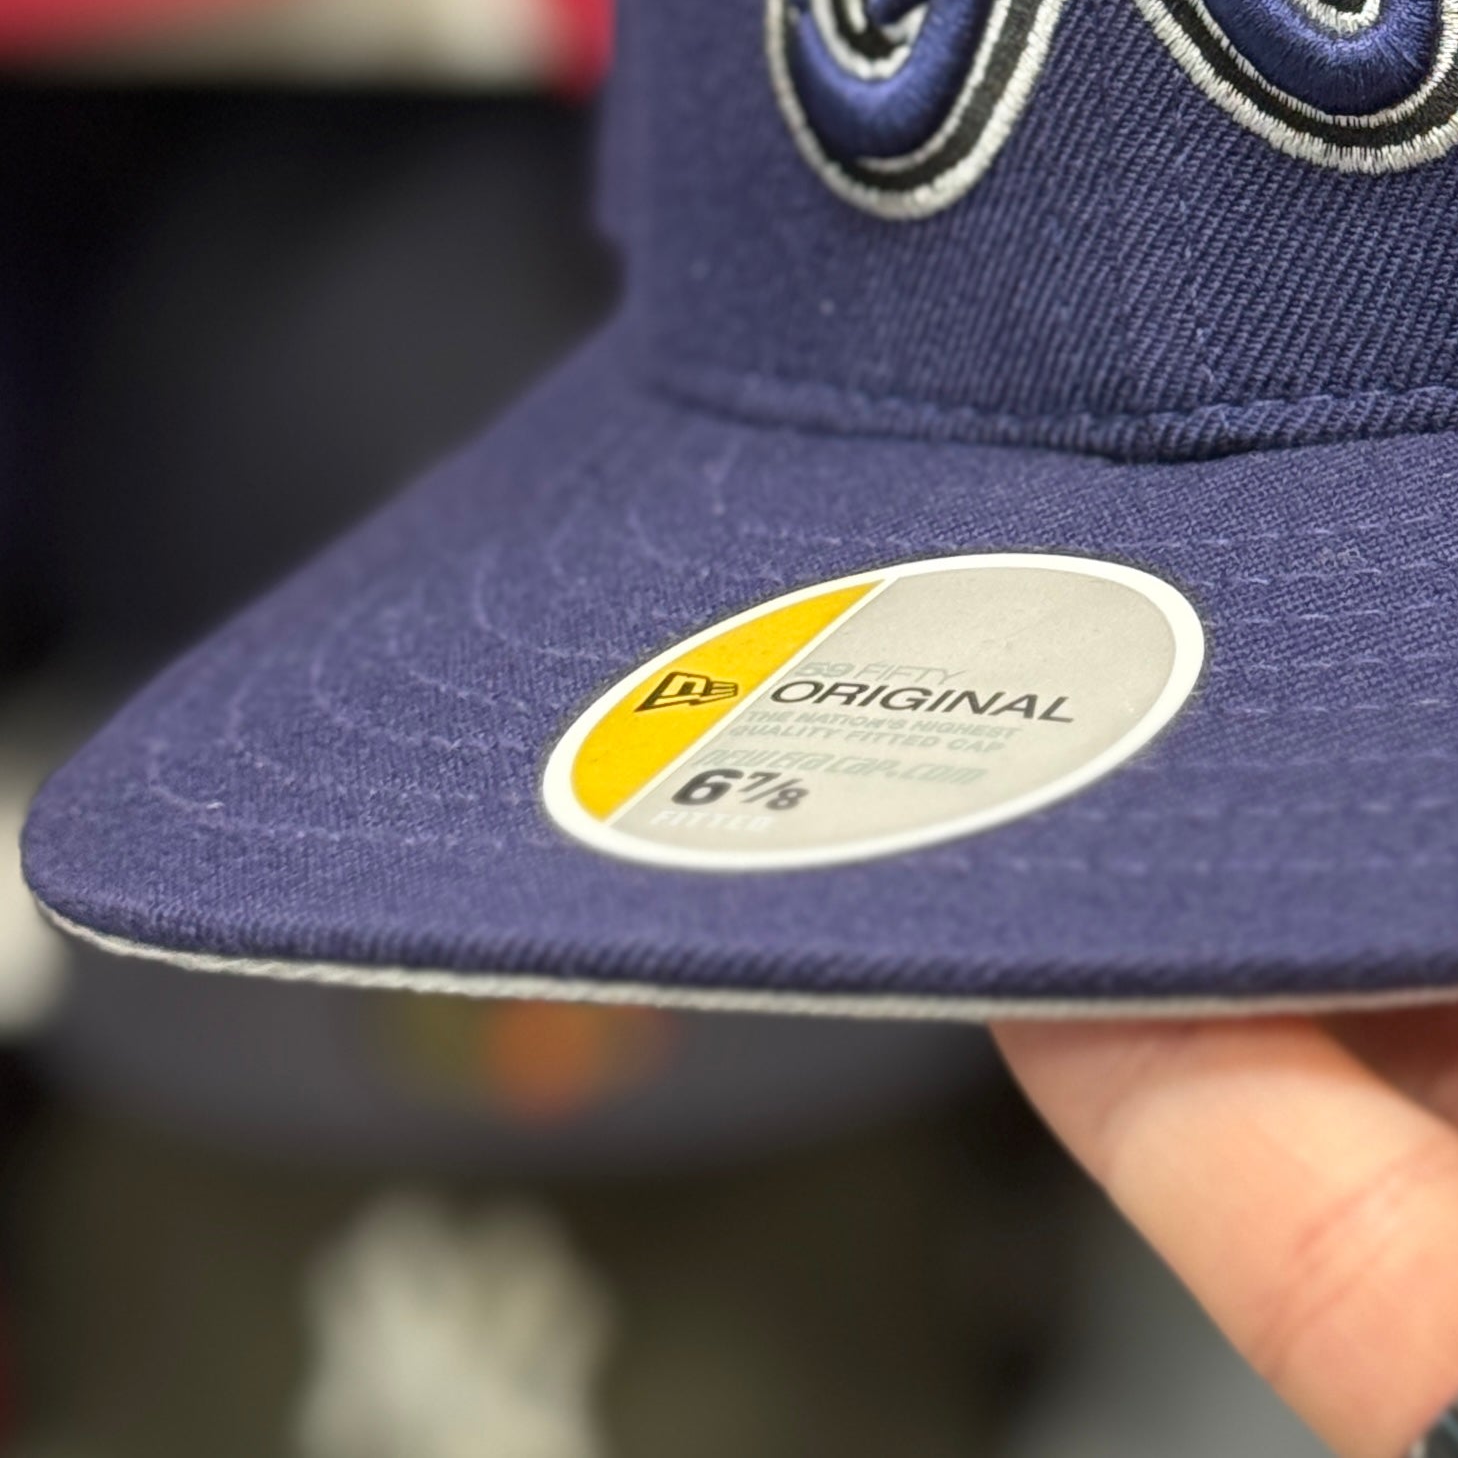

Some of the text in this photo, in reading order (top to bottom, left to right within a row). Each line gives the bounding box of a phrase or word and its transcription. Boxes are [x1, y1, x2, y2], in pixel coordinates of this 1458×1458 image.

[770, 680, 1075, 723] ORIGINAL
[746, 710, 787, 723] THE
[909, 719, 1022, 739] HIGHEST
[728, 725, 1006, 754] QUALITY FITTED CAP
[649, 810, 777, 830] FITTED
